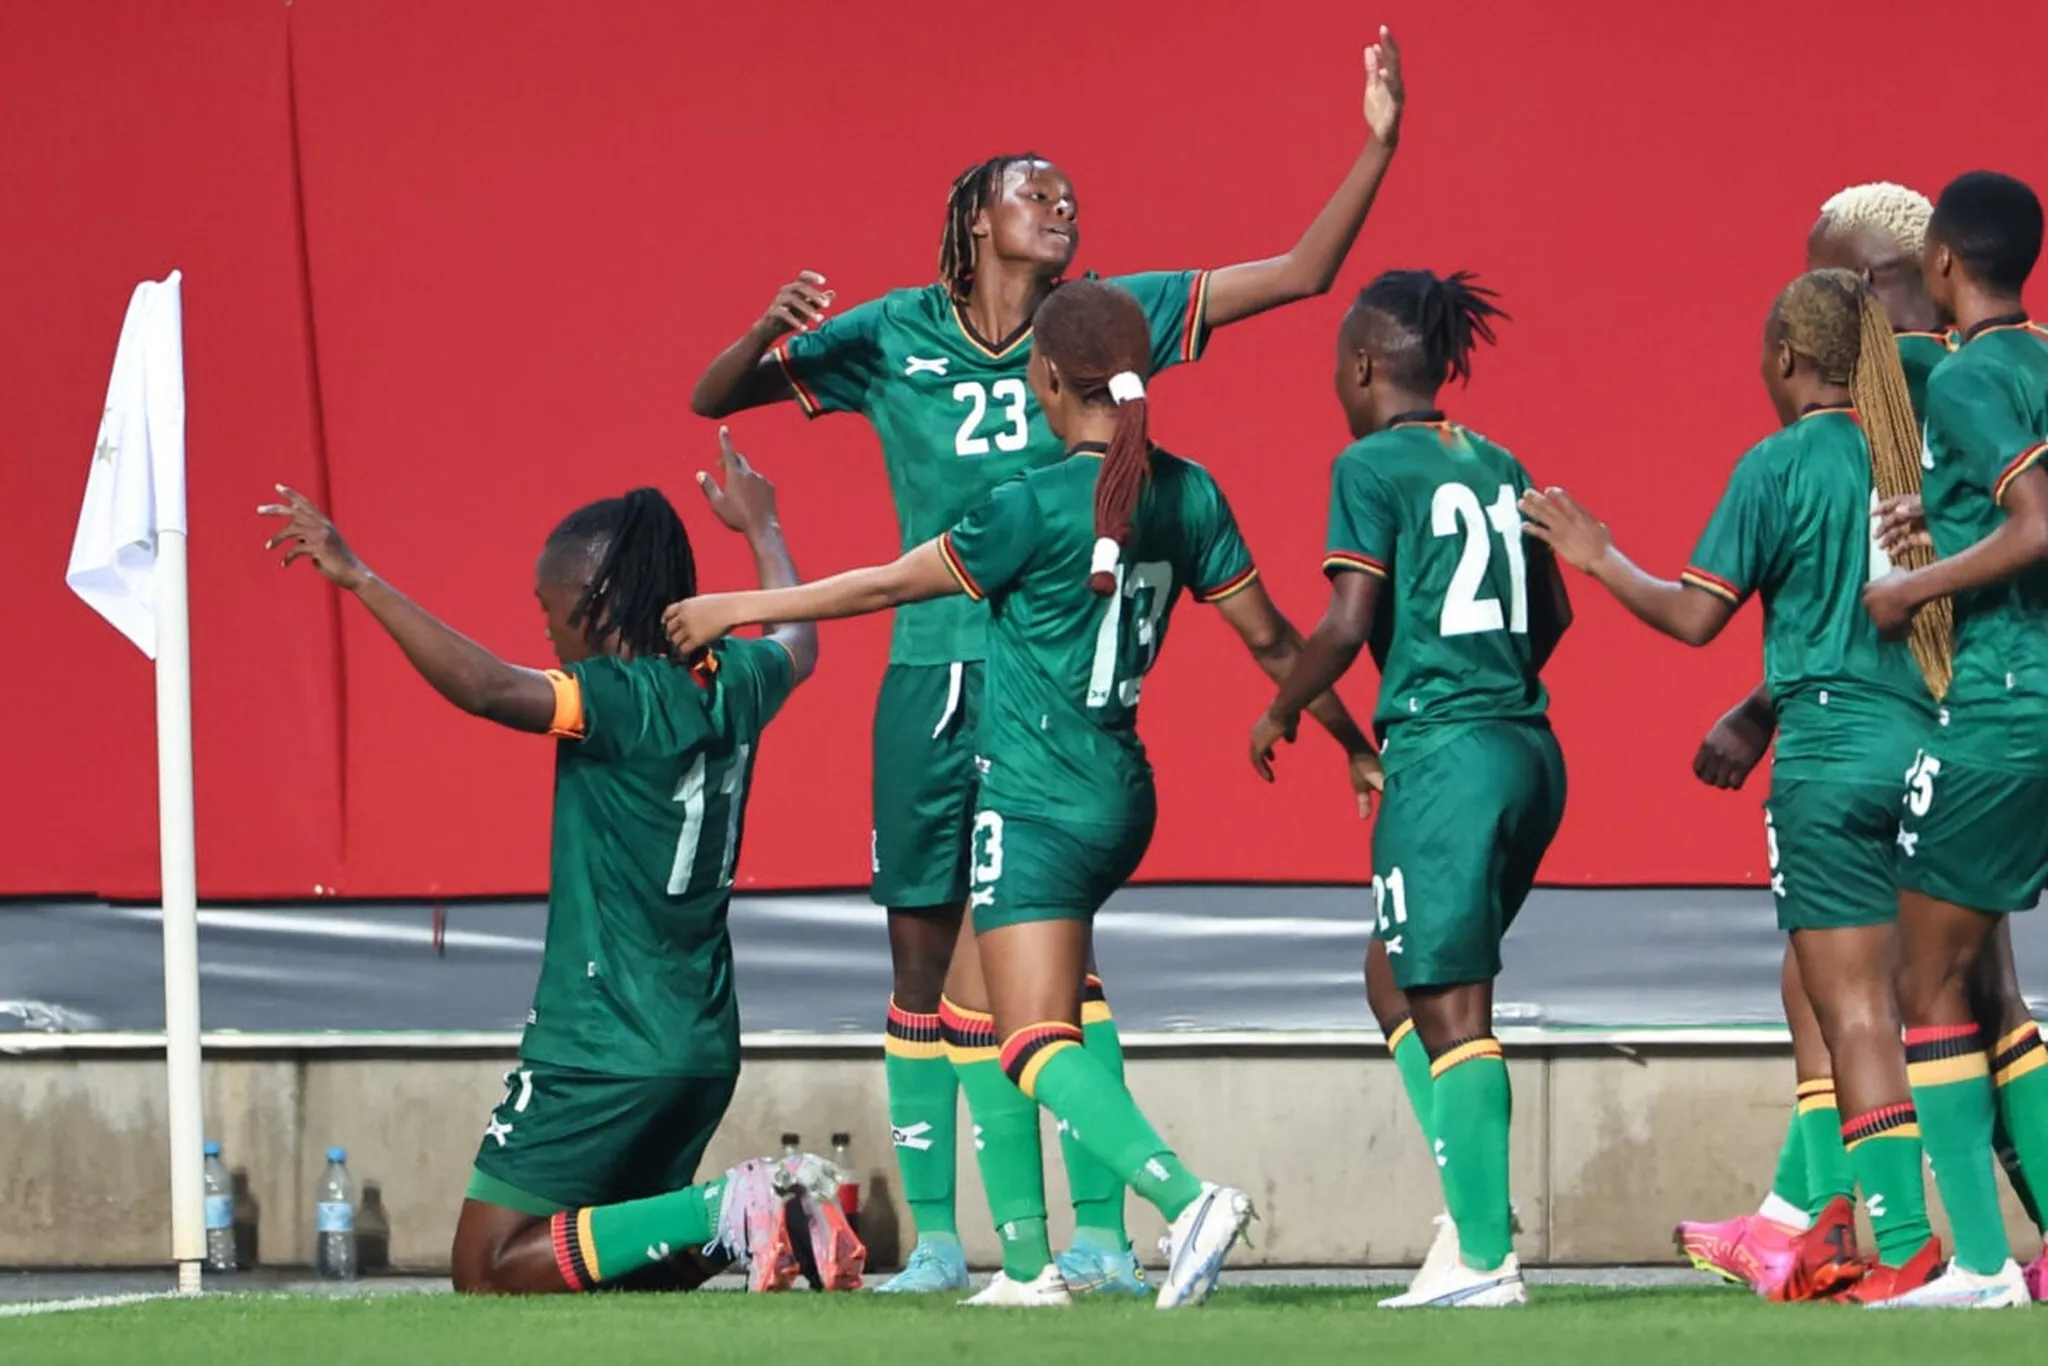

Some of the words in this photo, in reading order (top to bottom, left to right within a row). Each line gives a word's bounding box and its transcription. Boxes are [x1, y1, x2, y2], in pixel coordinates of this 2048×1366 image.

[953, 378, 1029, 456] 23
[1431, 482, 1528, 637] 21
[1086, 561, 1174, 708] 13
[666, 744, 750, 896] 11
[1372, 866, 1407, 932] 21
